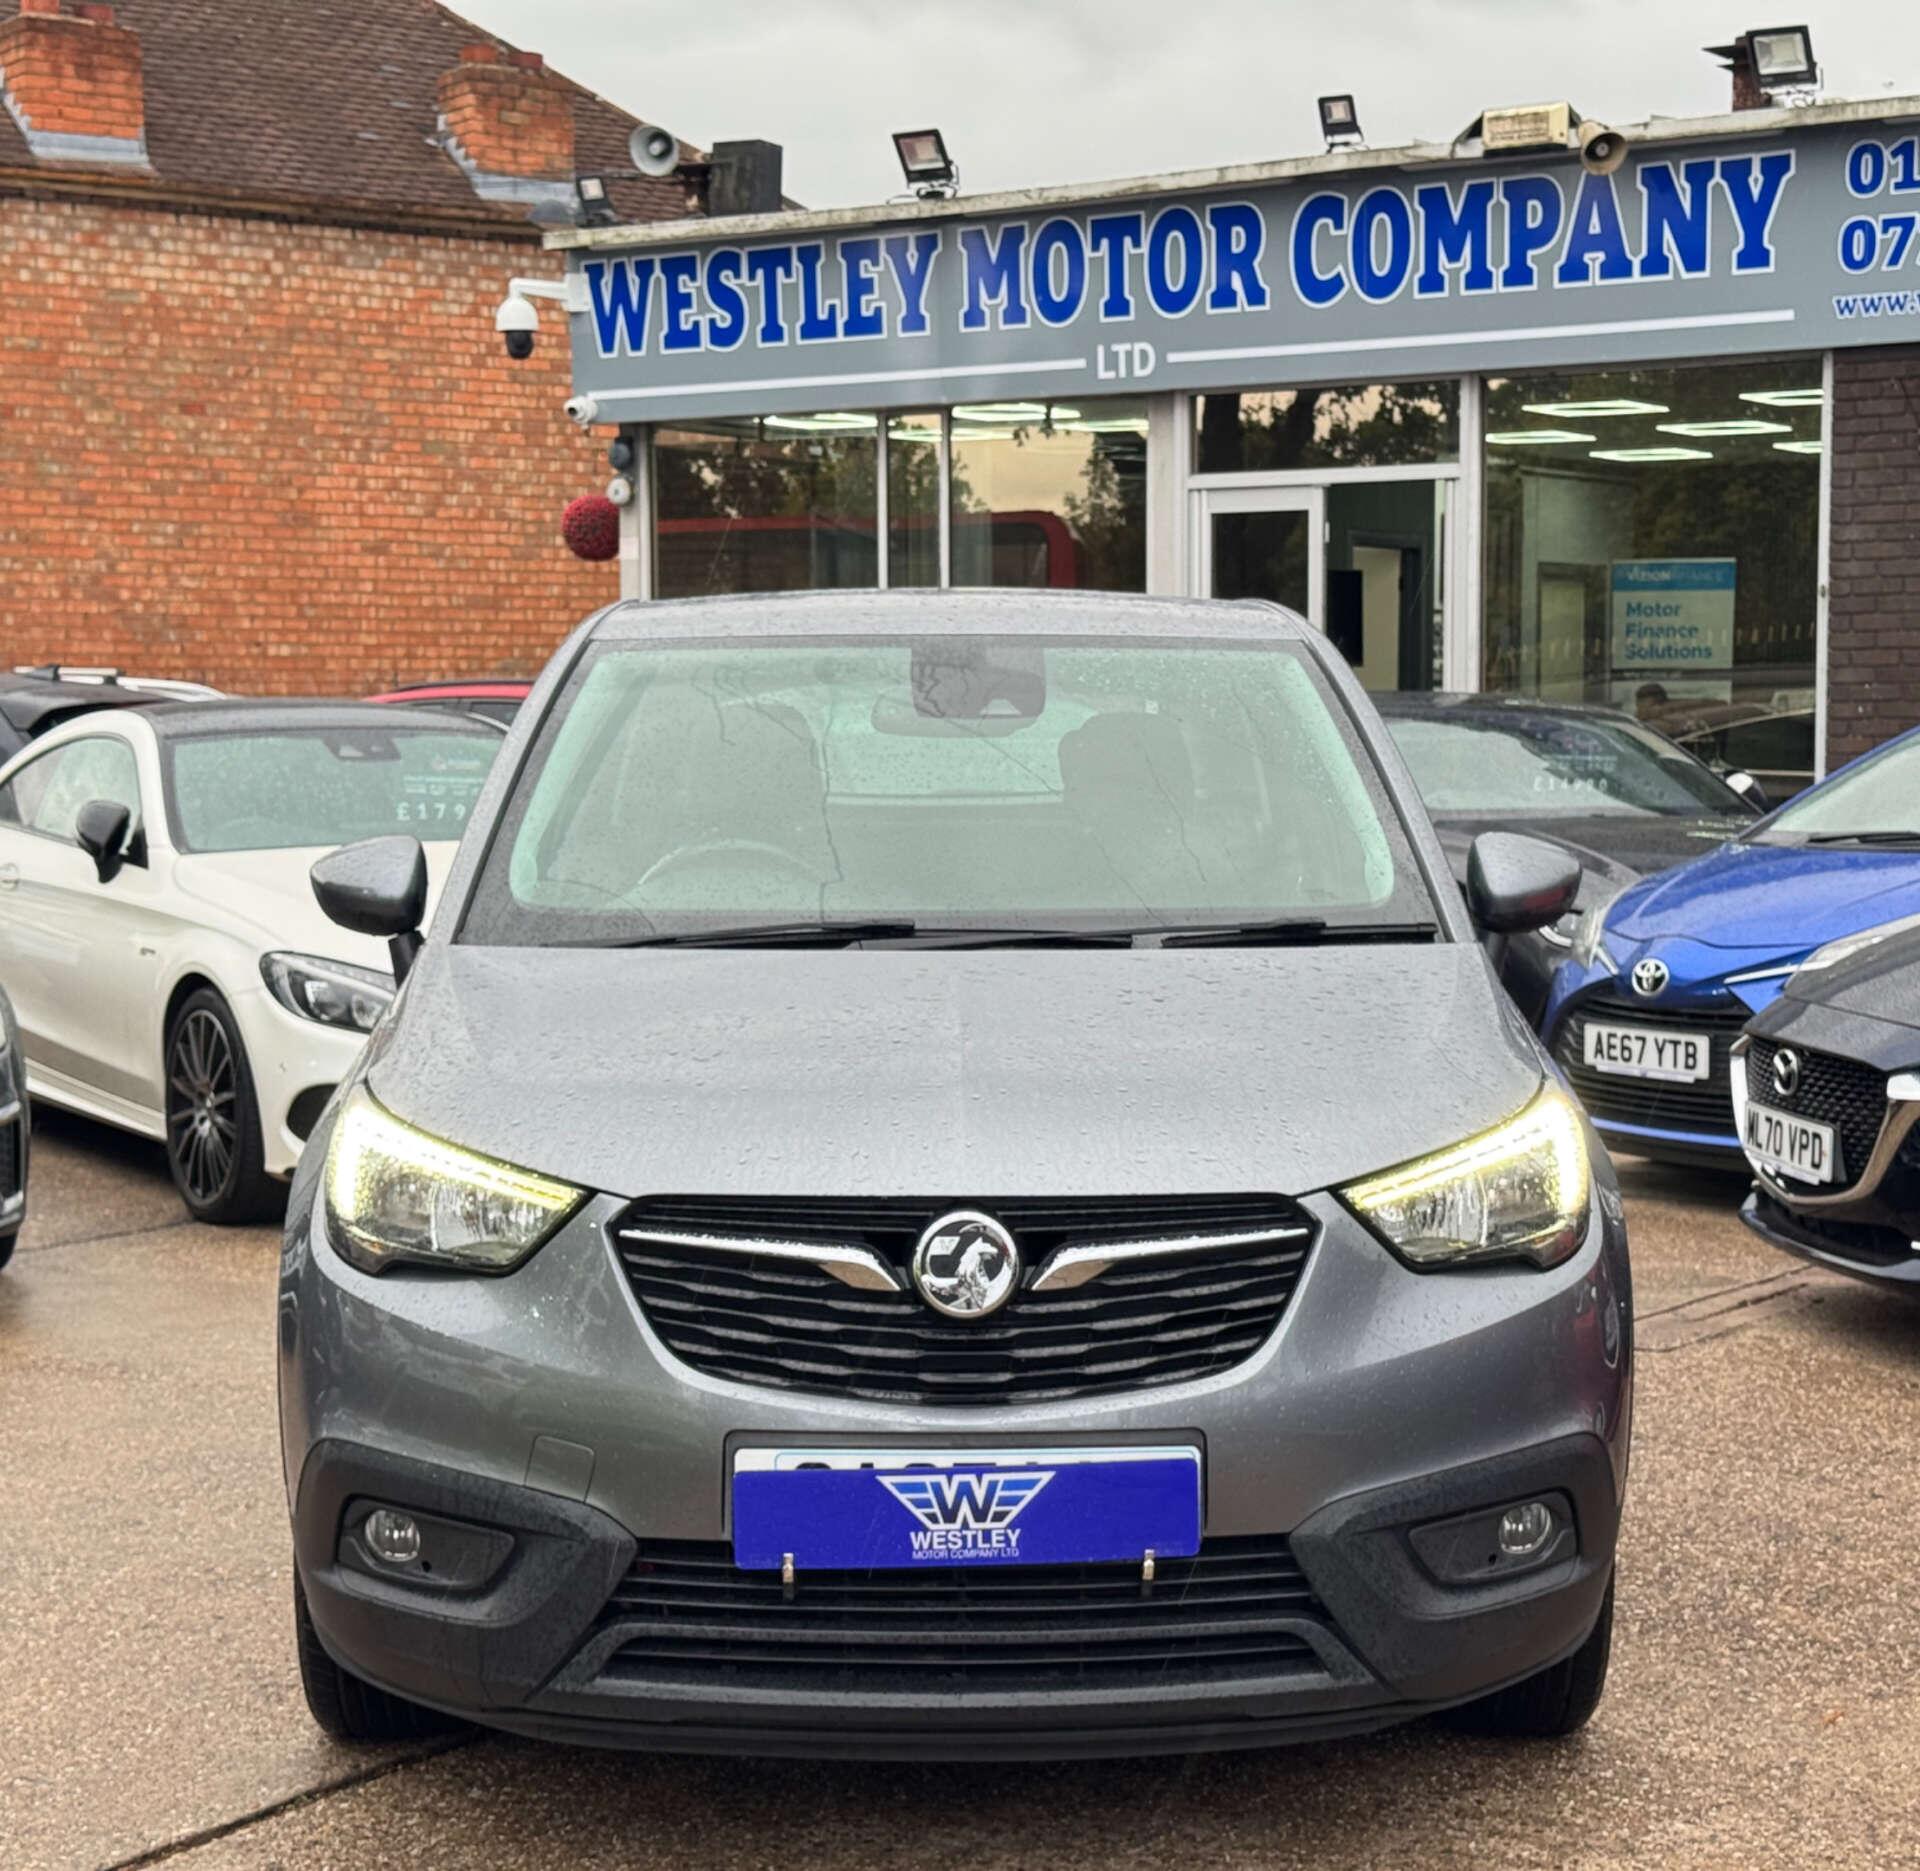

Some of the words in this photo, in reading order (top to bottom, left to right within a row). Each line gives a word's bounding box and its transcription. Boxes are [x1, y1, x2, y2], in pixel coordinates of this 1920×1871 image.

[584, 230, 942, 359] WESTLEY
[957, 203, 1270, 334] MOTOR
[1290, 150, 1797, 309] COMPANY
[1838, 212, 1920, 275] 07
[1832, 290, 1920, 319] www.
[1097, 342, 1157, 380] LTD
[1625, 602, 1682, 618] Motor
[1625, 622, 1700, 639] Finance
[1625, 643, 1713, 661] Solutions
[1593, 1032, 1647, 1065] AE67
[1653, 1038, 1698, 1071] YTB
[1788, 1122, 1823, 1171] VPD
[909, 1528, 1022, 1551] WESTLEY
[912, 1549, 949, 1560] MOTOR
[950, 1548, 998, 1559] COMPANY
[1001, 1547, 1020, 1558] LTD
